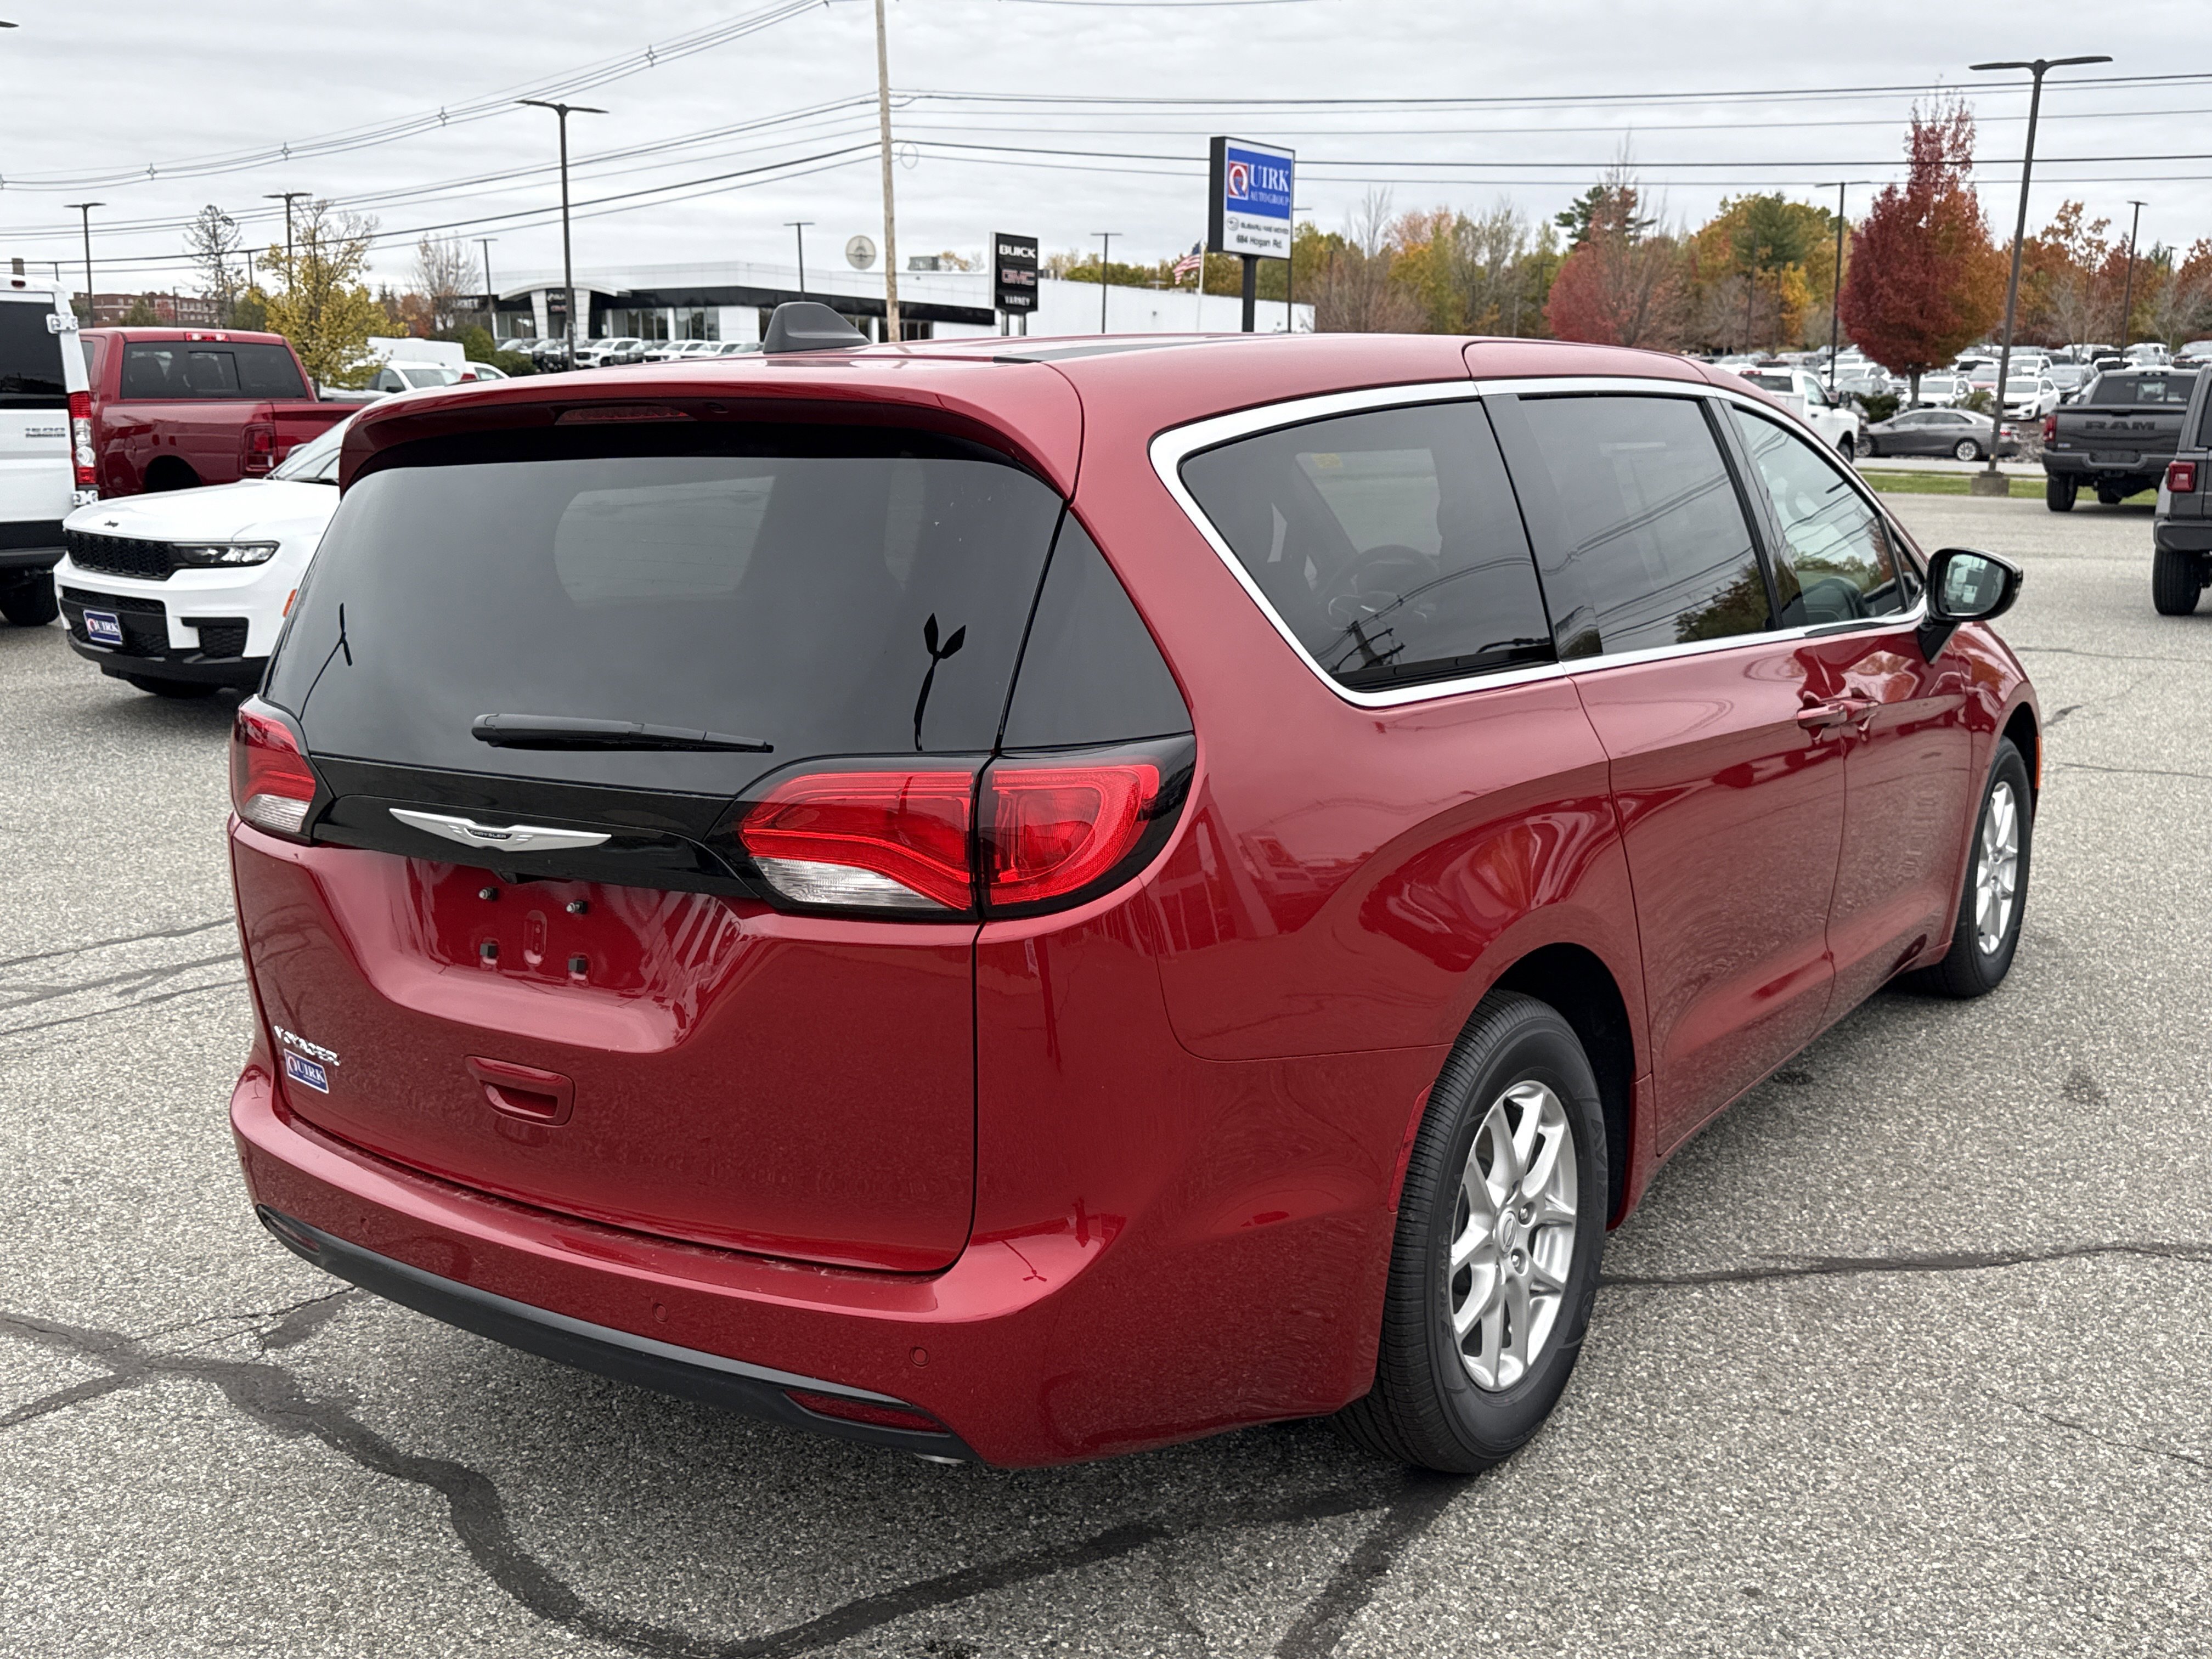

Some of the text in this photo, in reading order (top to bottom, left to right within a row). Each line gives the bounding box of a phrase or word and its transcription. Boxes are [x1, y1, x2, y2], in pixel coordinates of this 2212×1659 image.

[1229, 164, 1289, 198] QUIRK
[1250, 237, 1271, 247] Hogan
[999, 244, 1036, 259] BUICK
[1001, 269, 1035, 285] GMC
[2085, 421, 2155, 430] RAM
[274, 1025, 341, 1066] VOYAGER
[288, 1057, 326, 1083] QUIRK
